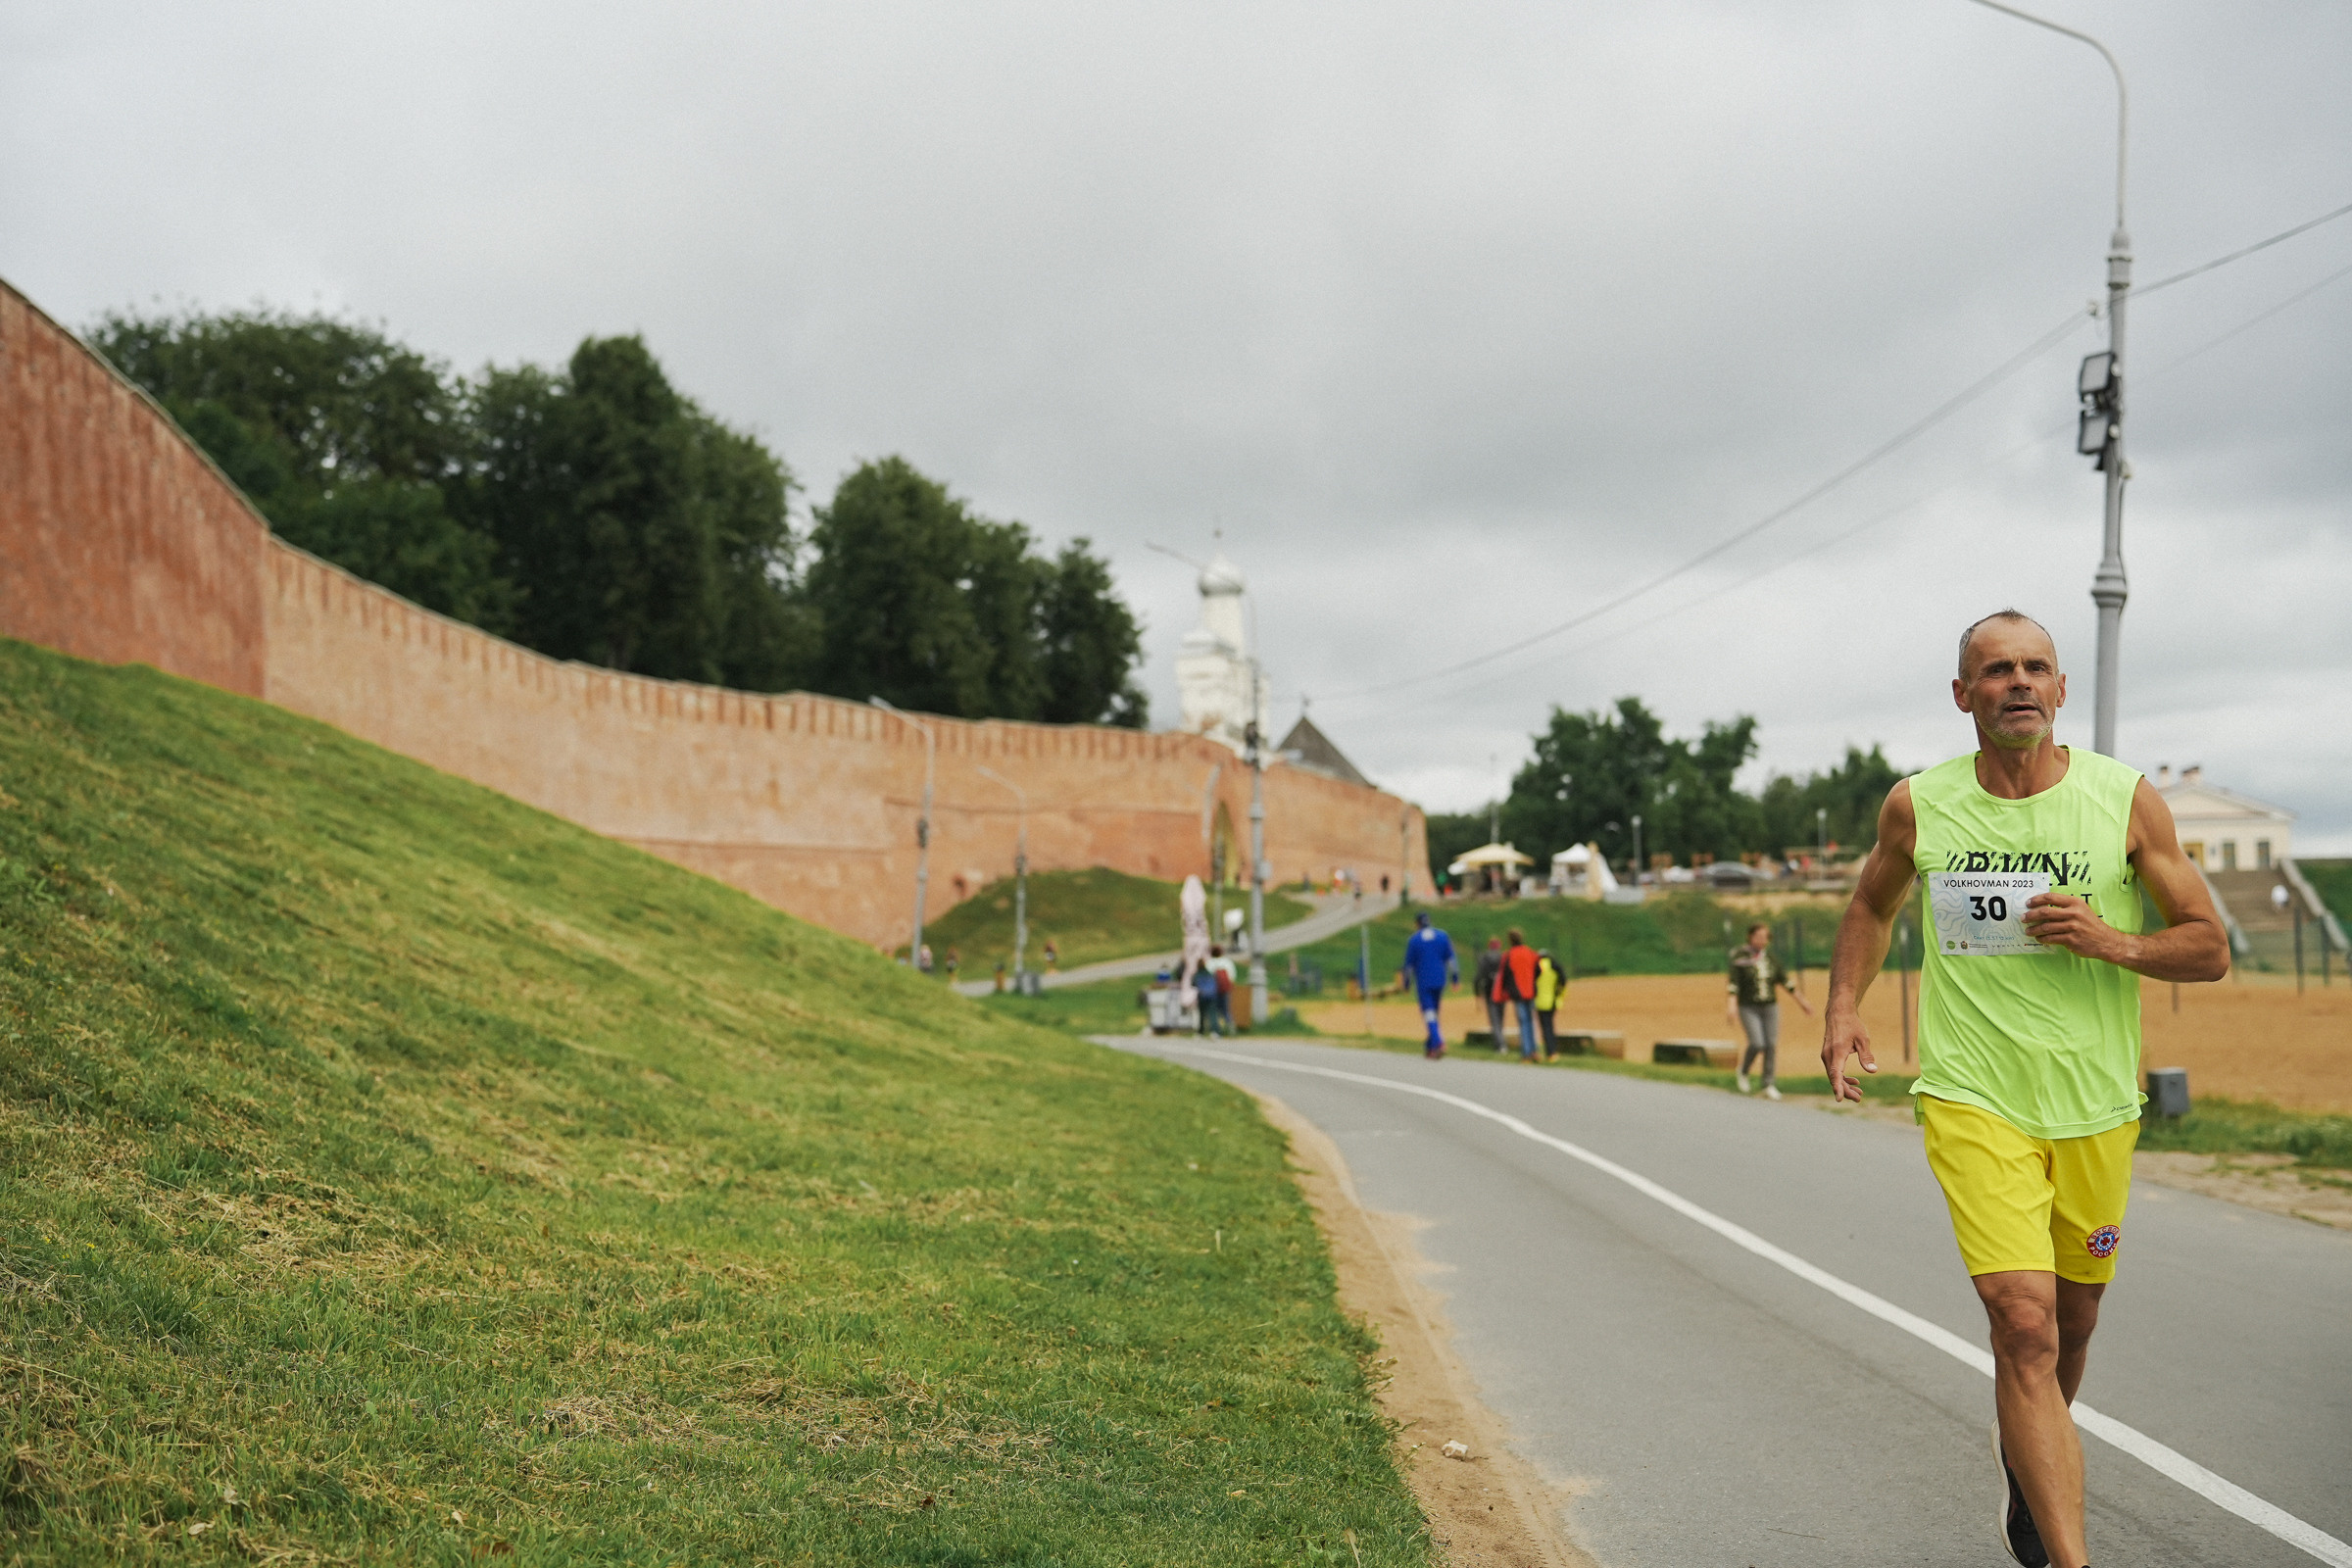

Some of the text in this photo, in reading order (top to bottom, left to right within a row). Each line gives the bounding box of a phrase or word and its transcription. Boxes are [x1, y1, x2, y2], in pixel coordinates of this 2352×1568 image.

[1943, 879, 2034, 888] VOLKHOVMAN 2023
[1969, 896, 2007, 921] 30
